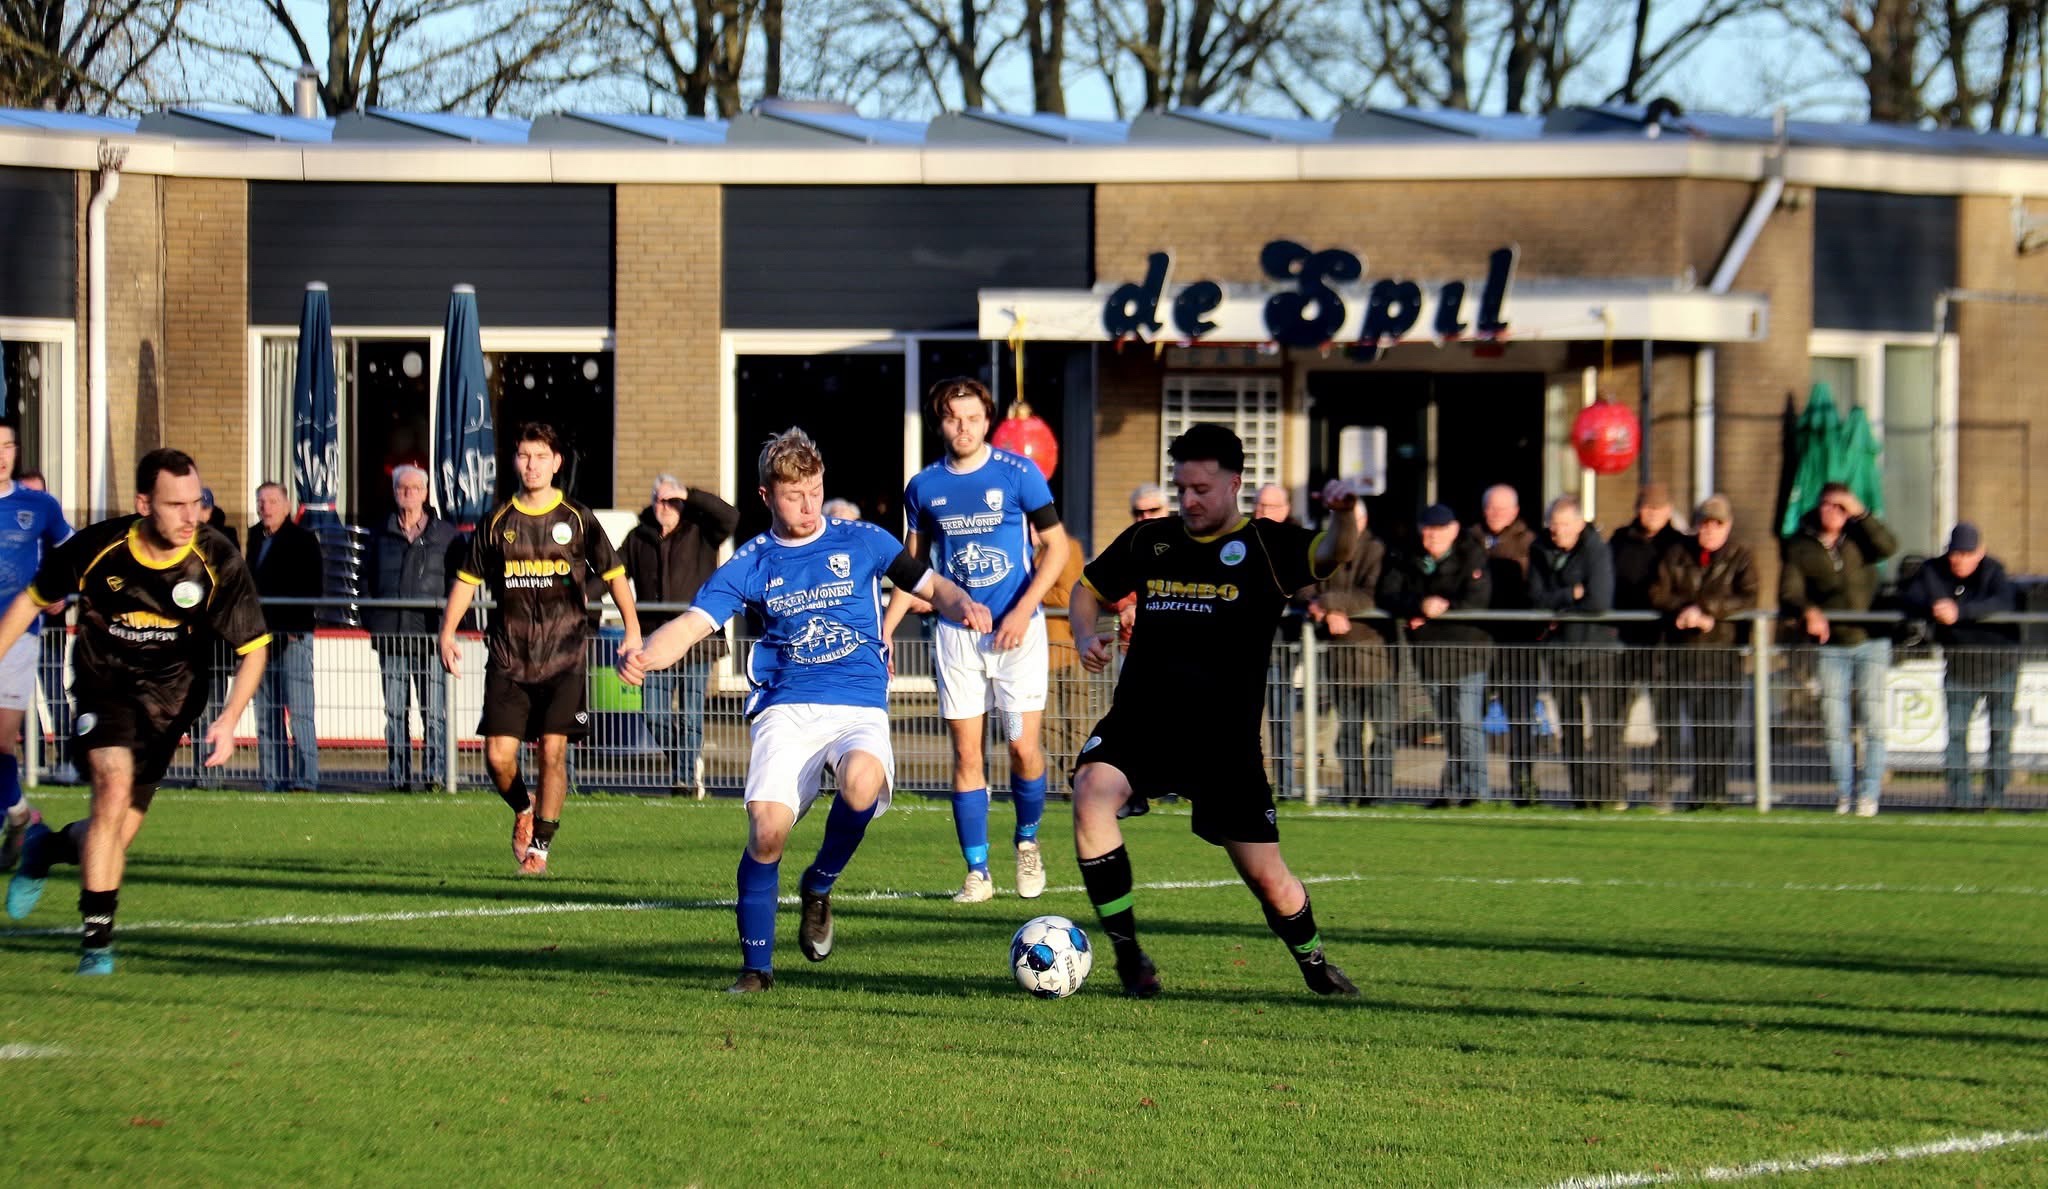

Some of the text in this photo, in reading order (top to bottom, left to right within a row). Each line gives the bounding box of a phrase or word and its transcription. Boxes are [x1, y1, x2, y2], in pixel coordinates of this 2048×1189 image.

[1103, 239, 1518, 362] de Spil
[504, 559, 571, 578] JUMBO
[1146, 579, 1239, 602] JUMBO
[1145, 601, 1213, 613] GILDEPLEIN
